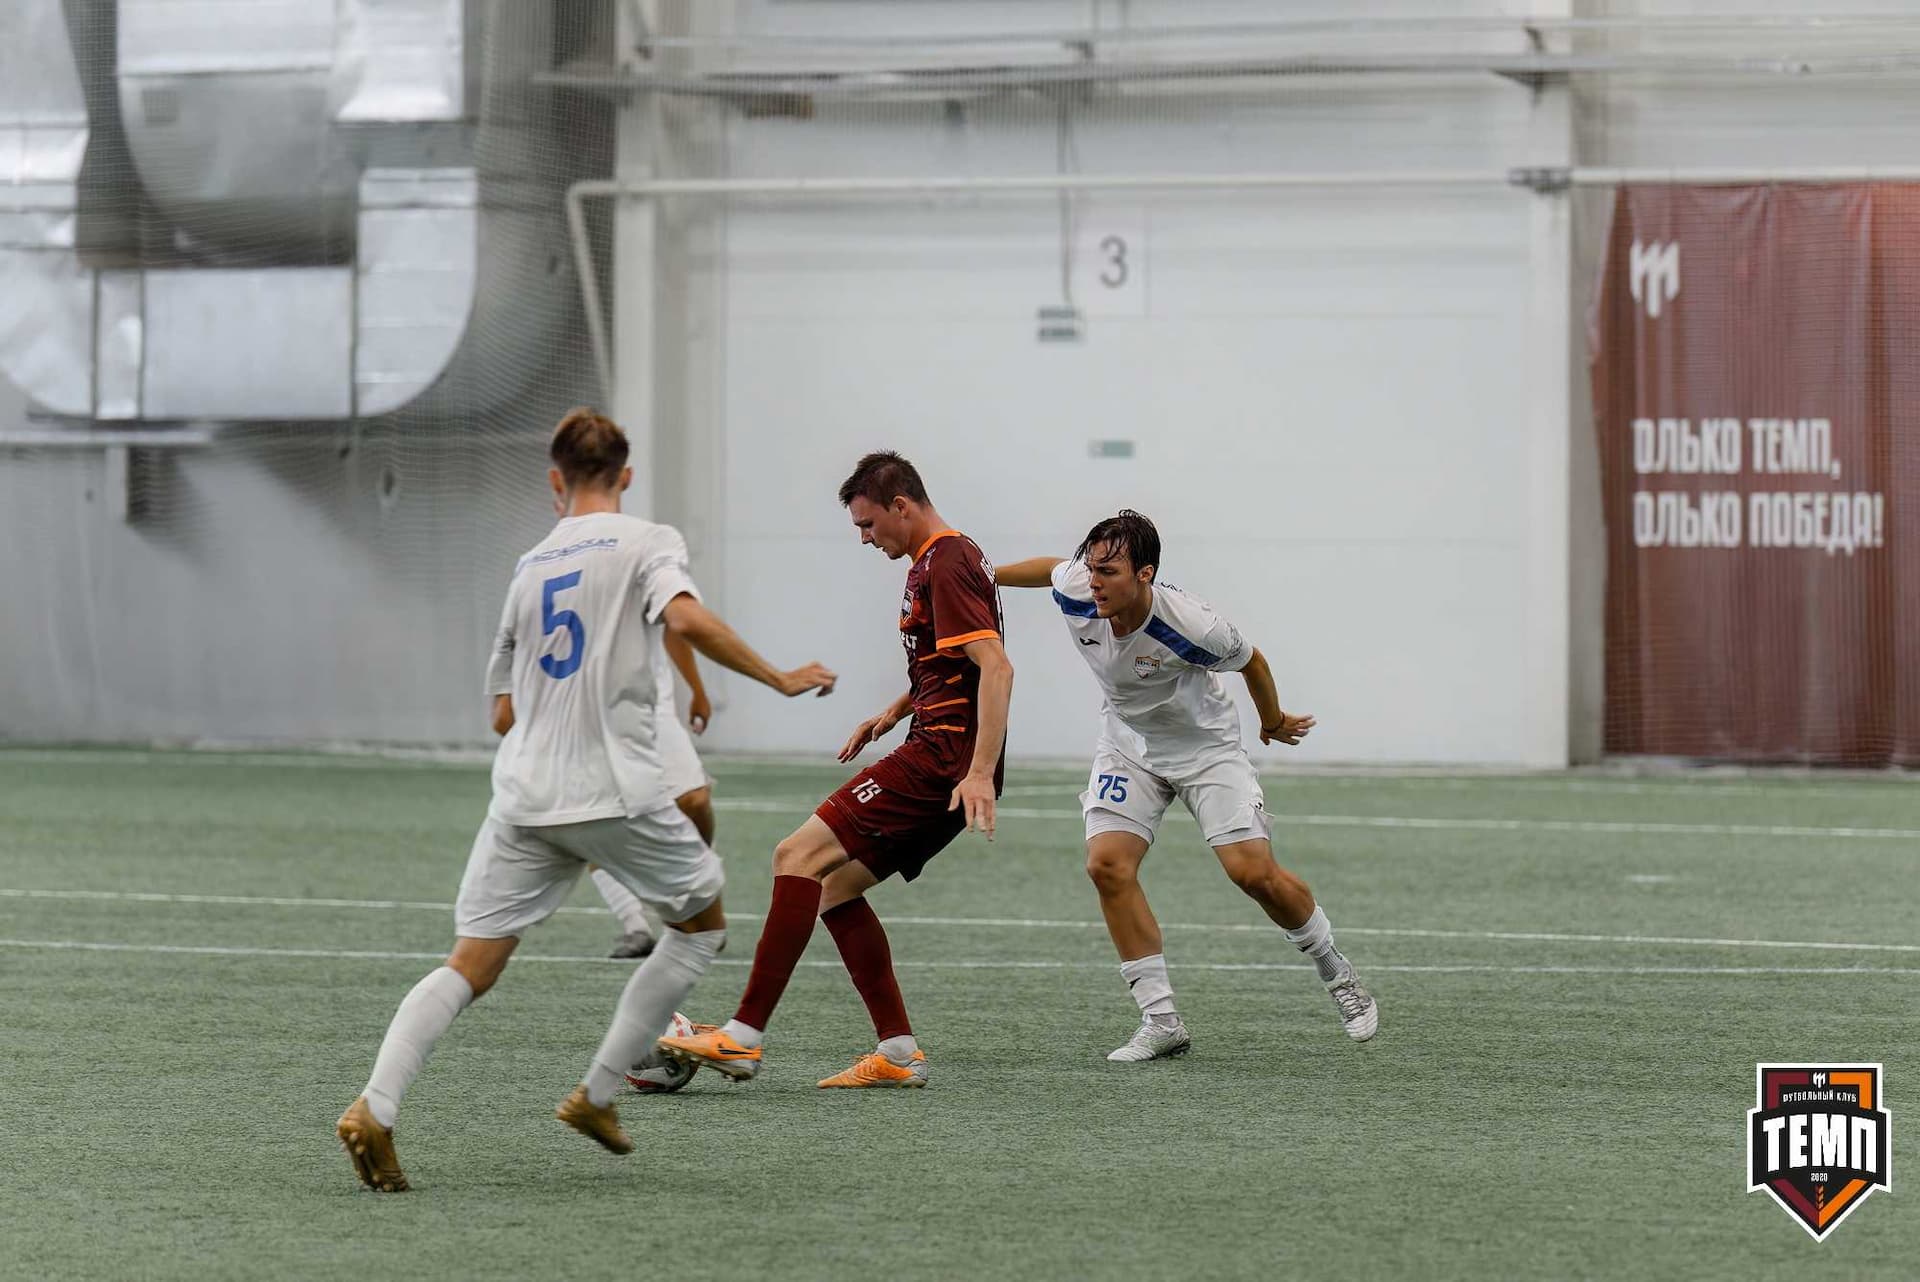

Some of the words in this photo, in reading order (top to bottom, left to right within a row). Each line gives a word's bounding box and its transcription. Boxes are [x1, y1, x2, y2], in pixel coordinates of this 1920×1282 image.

[1099, 233, 1129, 289] 3
[1630, 417, 1742, 475] ОЛЬКО
[1747, 417, 1841, 480] ТЕМП,
[1748, 491, 1884, 557] ПОБЕДА!
[539, 569, 585, 680] 5
[851, 778, 883, 804] 15
[1097, 773, 1129, 803] 75
